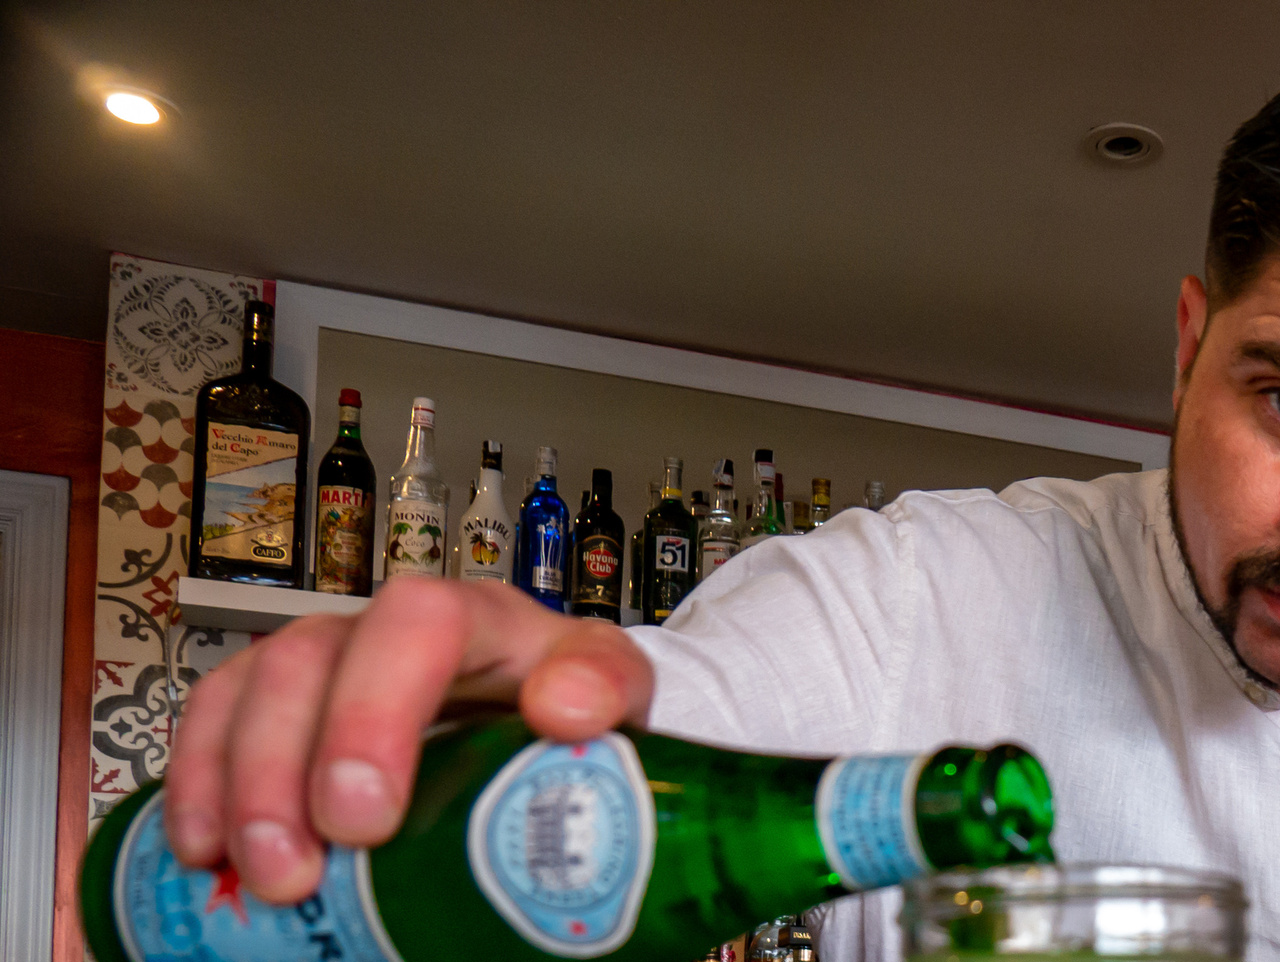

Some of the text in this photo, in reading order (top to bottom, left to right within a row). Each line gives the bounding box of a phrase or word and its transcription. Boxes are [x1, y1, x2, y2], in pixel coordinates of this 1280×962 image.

[212, 428, 296, 450] Vecchio Amaro
[212, 441, 259, 456] del Capo
[394, 512, 440, 525] MONIN
[463, 517, 512, 541] MALIBU
[256, 547, 282, 557] CAFFO
[583, 551, 619, 566] Havana
[659, 541, 686, 568] 51
[589, 561, 612, 574] Club
[595, 584, 605, 597] 7
